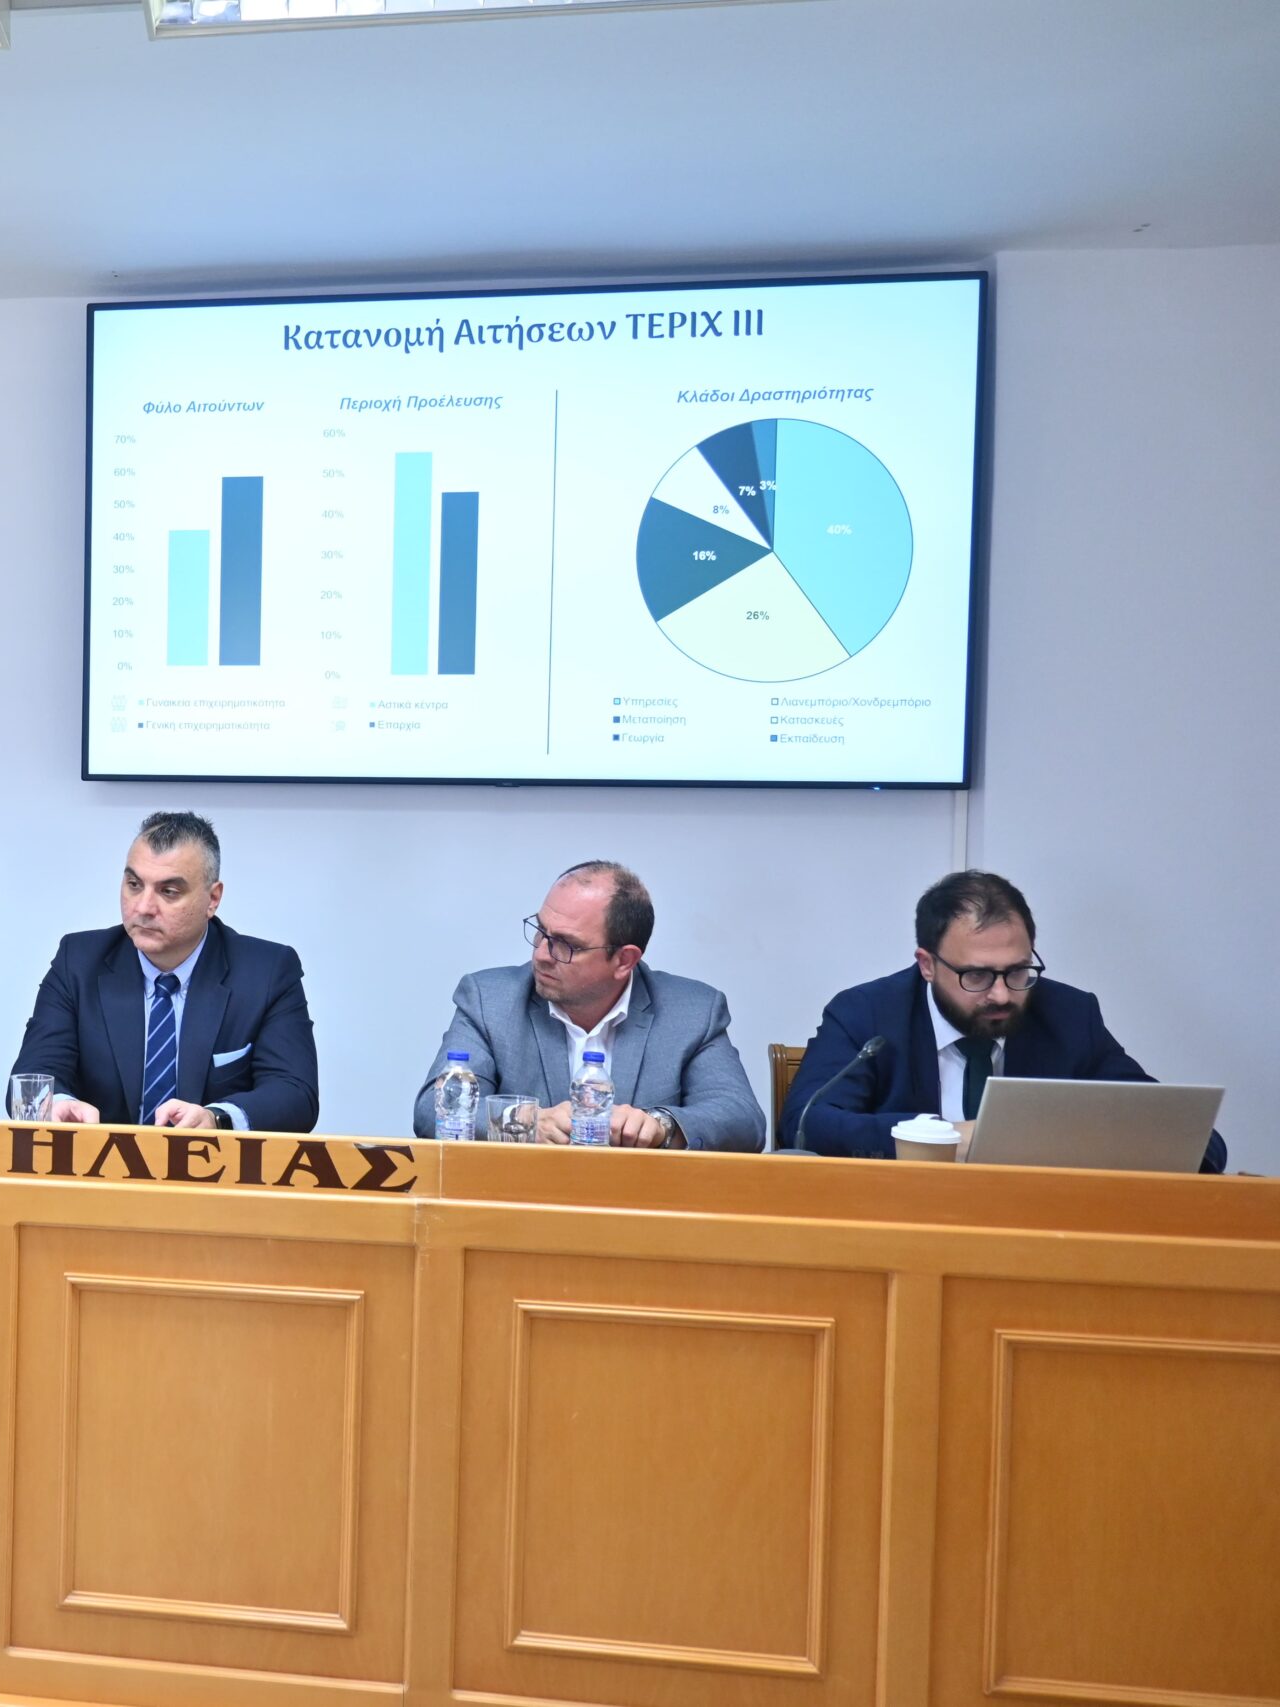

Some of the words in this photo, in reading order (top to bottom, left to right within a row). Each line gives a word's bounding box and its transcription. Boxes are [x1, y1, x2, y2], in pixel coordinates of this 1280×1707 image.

[283, 317, 445, 355] Κατανομή
[453, 315, 617, 351] Αιτήσεων
[733, 308, 764, 337] III
[676, 389, 736, 404] Κλάδοι
[738, 385, 875, 405] Δραστηριότητας
[142, 401, 182, 415] Φύλο
[185, 399, 265, 413] Αιτούντων
[339, 395, 402, 413] Περιοχή
[406, 394, 504, 412] Προέλευσης
[322, 428, 346, 439] 60%
[115, 434, 137, 445] 70%
[113, 467, 136, 477] 60%
[322, 468, 345, 479] 50%
[759, 479, 776, 491] 3%
[738, 485, 757, 497] 7%
[113, 499, 136, 509] 50%
[712, 504, 730, 515] 8%
[321, 509, 345, 520] 40%
[826, 524, 853, 535] 40%
[112, 531, 135, 542] 40%
[320, 549, 344, 561] 30%
[692, 550, 717, 561] 16%
[112, 564, 135, 575] 30%
[320, 589, 343, 600] 20%
[111, 596, 134, 607] 20%
[745, 610, 770, 621] 26%
[112, 628, 134, 639] 10%
[320, 630, 343, 640] 10%
[116, 661, 133, 672] 0%
[324, 670, 342, 681] 0%
[622, 696, 679, 709] Υπηρεσίες
[780, 697, 932, 710] Λιανεμπόριο/Χονδρεμπόριο
[377, 719, 421, 732] Επαρχία
[621, 714, 687, 726] Μεταποίηση
[779, 715, 845, 728] Κατασκευές
[621, 732, 665, 745] Γεωργία
[779, 733, 845, 745] Εκπαίδευση
[6, 1126, 418, 1193] ΗΛΕΙΑΣ
